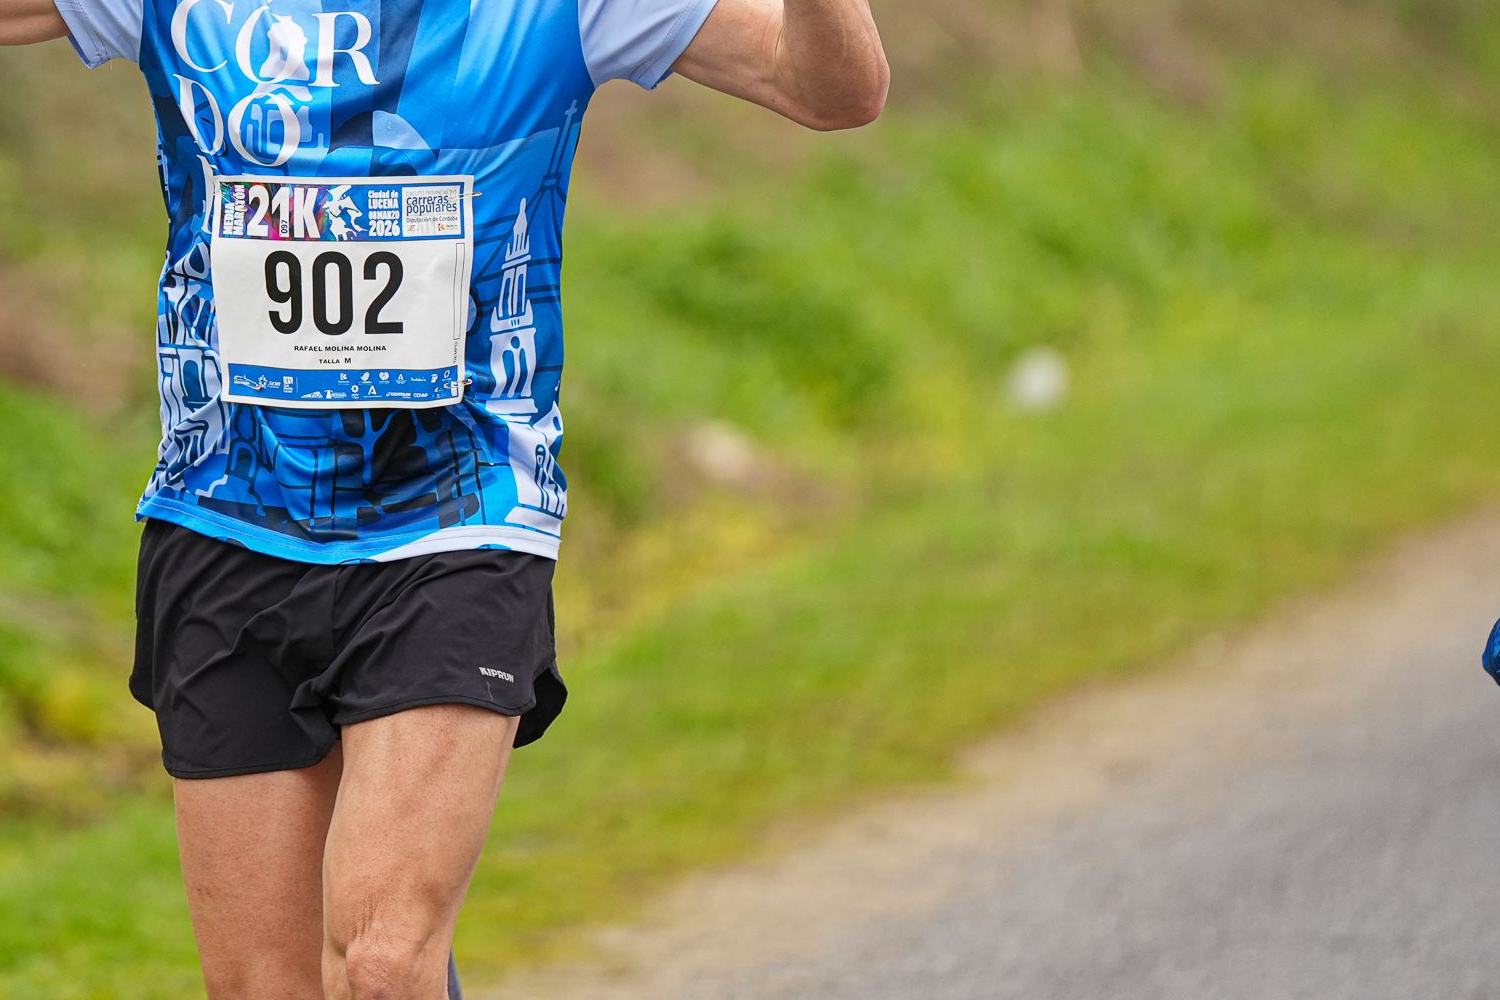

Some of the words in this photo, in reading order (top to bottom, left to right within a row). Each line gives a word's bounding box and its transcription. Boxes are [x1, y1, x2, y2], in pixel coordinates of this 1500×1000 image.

[367, 190, 390, 199] Ciudad
[391, 190, 399, 199] de
[406, 195, 449, 206] carreras
[232, 184, 247, 236] MARATÓN
[247, 184, 321, 239] 21K
[368, 198, 399, 210] LUCENA
[406, 201, 458, 216] populares
[222, 203, 235, 235] MEDIA
[280, 219, 288, 234] 097
[406, 216, 431, 224] Diputación
[368, 219, 401, 237] 2026
[264, 250, 404, 336] 902
